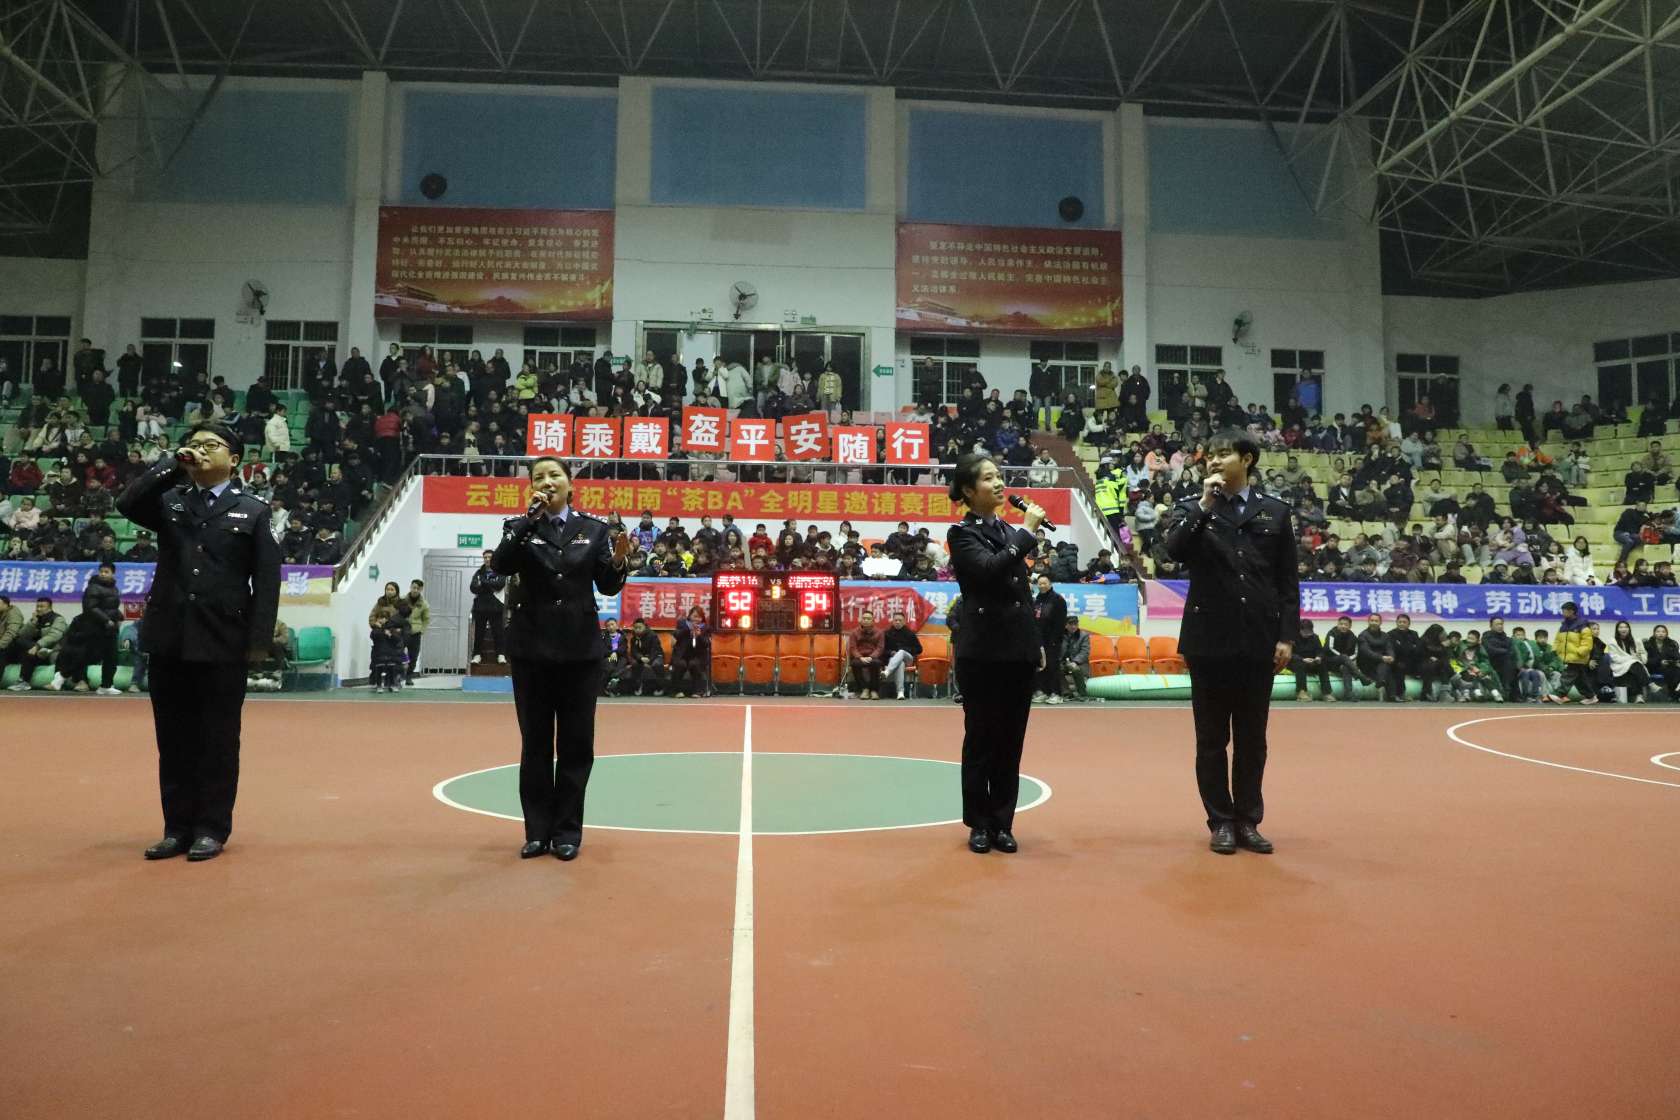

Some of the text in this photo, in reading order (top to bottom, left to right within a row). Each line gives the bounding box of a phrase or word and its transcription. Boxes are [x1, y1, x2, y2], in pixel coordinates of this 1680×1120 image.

[287, 572, 310, 595] 彩
[771, 586, 780, 599] 3
[728, 591, 753, 612] 52
[804, 592, 827, 612] 34
